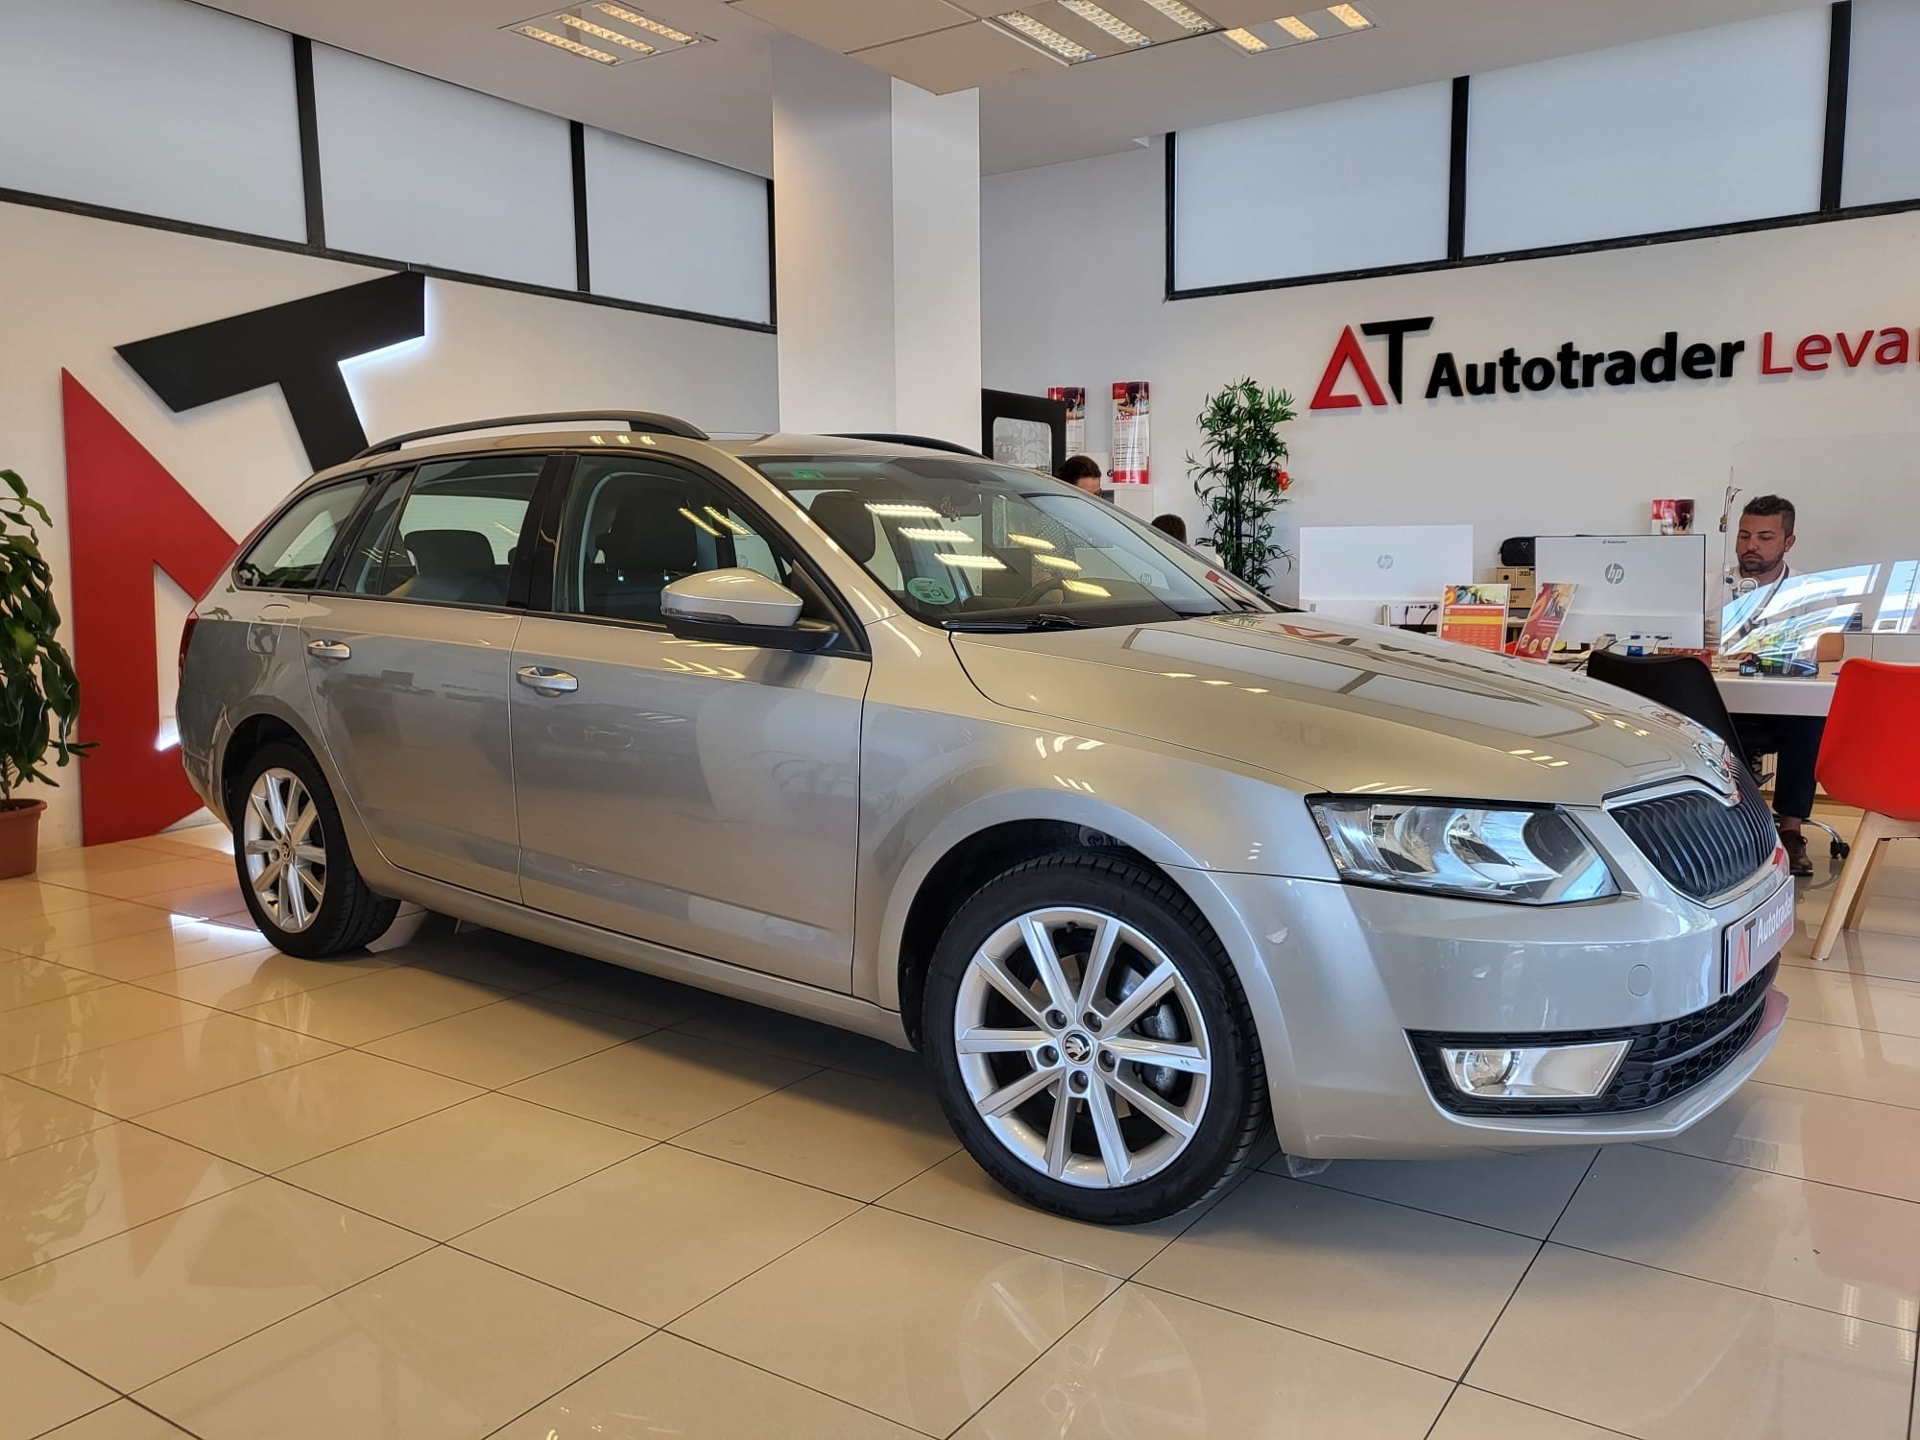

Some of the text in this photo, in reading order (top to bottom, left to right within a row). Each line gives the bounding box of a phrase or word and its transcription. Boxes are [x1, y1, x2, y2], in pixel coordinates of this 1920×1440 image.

[1309, 316, 1920, 409] AT Autotrader Leva
[1604, 563, 1625, 584] hp
